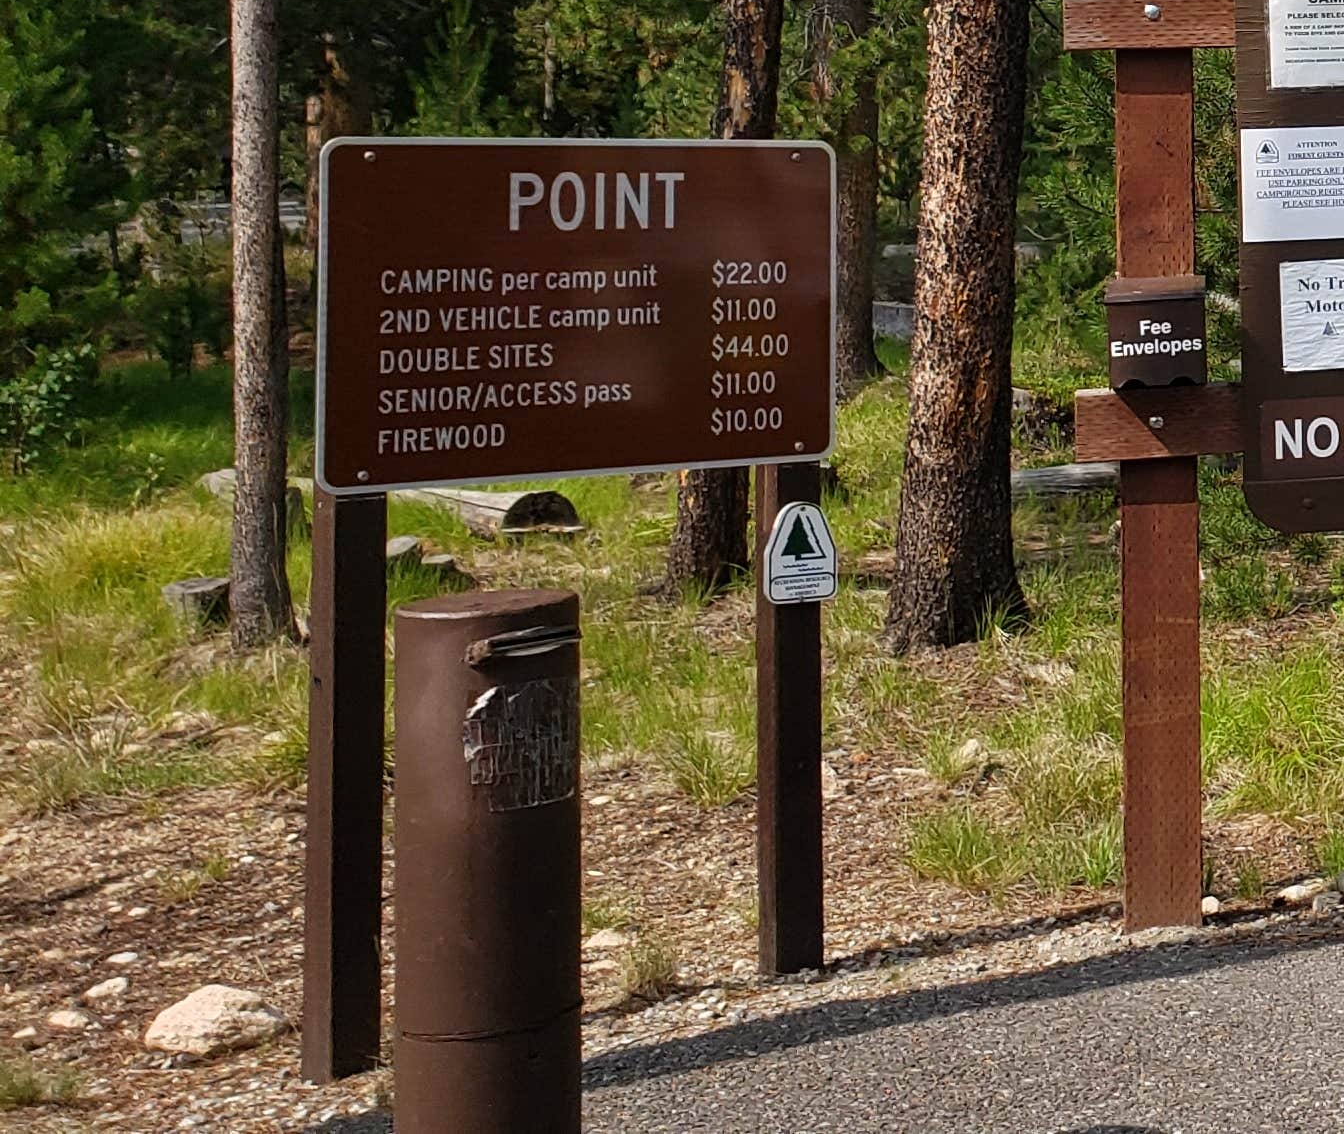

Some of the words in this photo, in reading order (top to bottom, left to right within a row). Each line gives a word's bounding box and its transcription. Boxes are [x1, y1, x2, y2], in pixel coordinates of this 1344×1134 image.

[1257, 169, 1272, 177] FEE
[1274, 168, 1322, 176] ENVELOPES
[1324, 167, 1341, 175] ARE
[1269, 180, 1285, 188] USE
[1287, 179, 1324, 187] PARKING
[509, 171, 685, 231] POINT
[1257, 189, 1317, 198] CAMPGROUND
[1283, 201, 1312, 209] PLEASE
[1315, 199, 1330, 208] SEE
[381, 268, 494, 294] CAMPING
[502, 271, 541, 296] per
[545, 269, 606, 294] camp
[614, 264, 658, 287] unit
[712, 259, 787, 288] $22.00
[1298, 278, 1320, 292] No
[379, 309, 431, 334] 2ND
[439, 305, 543, 332] VEHICLE
[549, 307, 610, 332] camp
[617, 301, 661, 325] unit
[711, 297, 776, 324] $11.00
[1139, 319, 1172, 336] Fee
[379, 346, 480, 374] DOUBLE
[488, 343, 553, 369] SITES
[711, 334, 789, 361] $44.00
[1111, 338, 1202, 357] Envelopes
[378, 381, 577, 415] SENIOR/ACCESS
[584, 382, 632, 408] pass
[711, 370, 776, 398] $11.00
[710, 407, 782, 435] $10.00
[378, 424, 506, 454] FIREWOOD
[1274, 417, 1340, 460] NO
